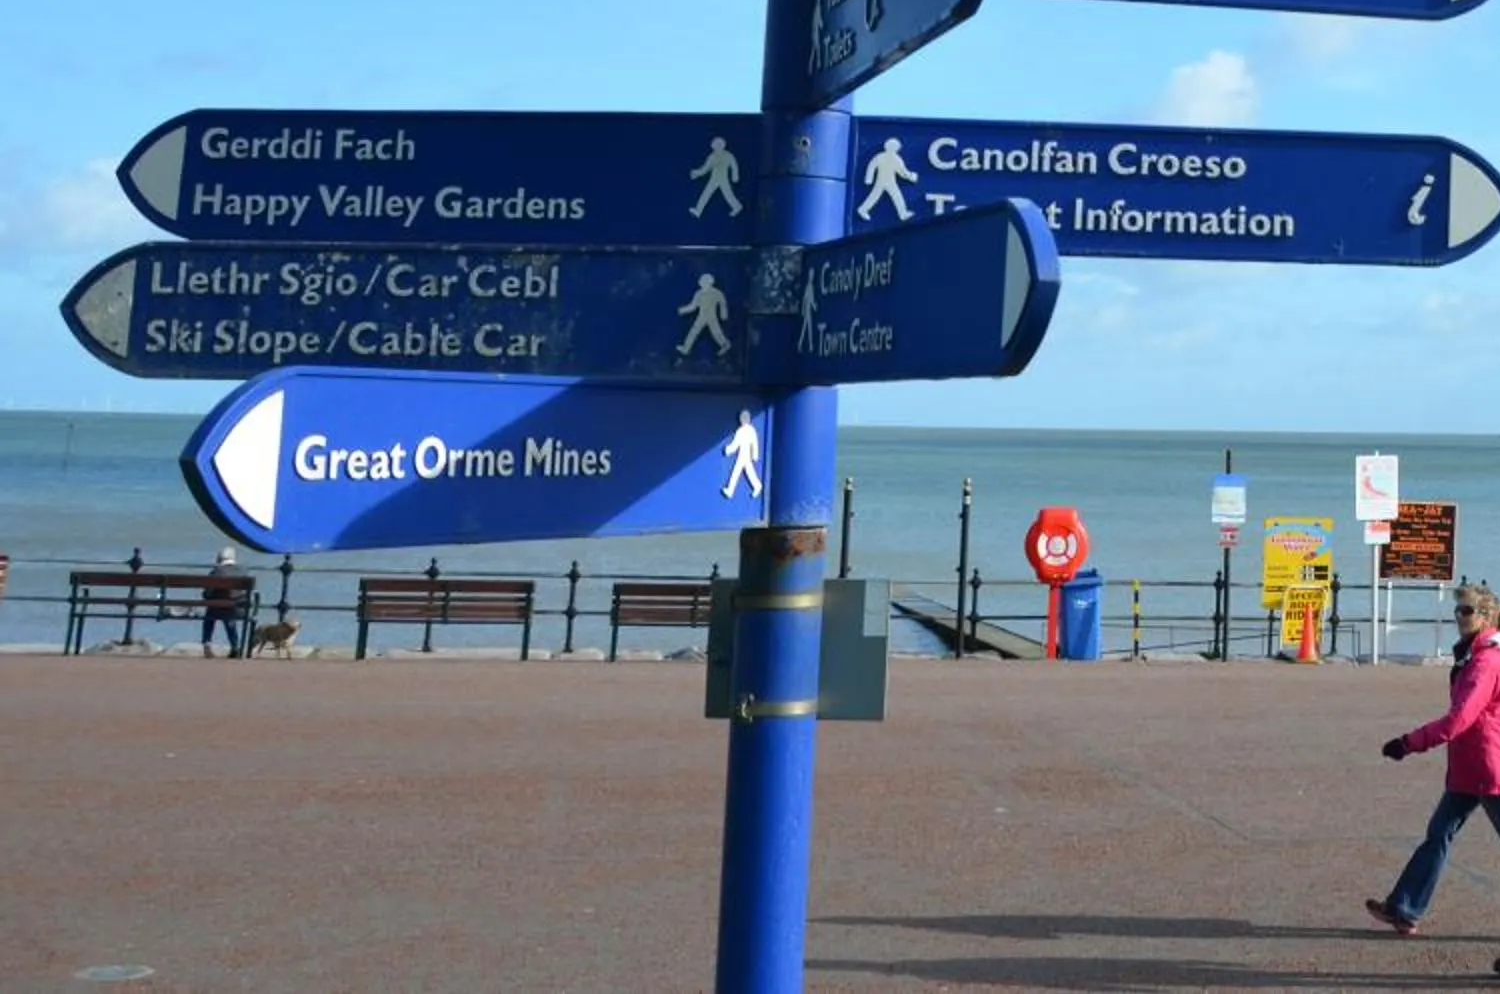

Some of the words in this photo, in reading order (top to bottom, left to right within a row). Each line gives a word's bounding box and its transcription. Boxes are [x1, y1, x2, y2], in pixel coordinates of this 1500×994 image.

[201, 127, 322, 160] Gerddi
[334, 129, 416, 161] Fach
[927, 137, 1098, 175] Canolfan
[1107, 142, 1248, 179] Croeso
[192, 183, 311, 226] Happy
[318, 184, 424, 228] Valley
[434, 186, 586, 220] Gardens
[1074, 198, 1295, 237] Information
[151, 261, 270, 295] Llethr
[467, 264, 560, 299] Cebl
[863, 245, 895, 289] Dref
[144, 318, 203, 353] Ski
[473, 323, 546, 357] Car
[817, 322, 848, 358] Town
[849, 317, 894, 355] Centre
[295, 435, 407, 481] Great
[414, 435, 514, 479] Orme
[523, 437, 611, 476] Mines
